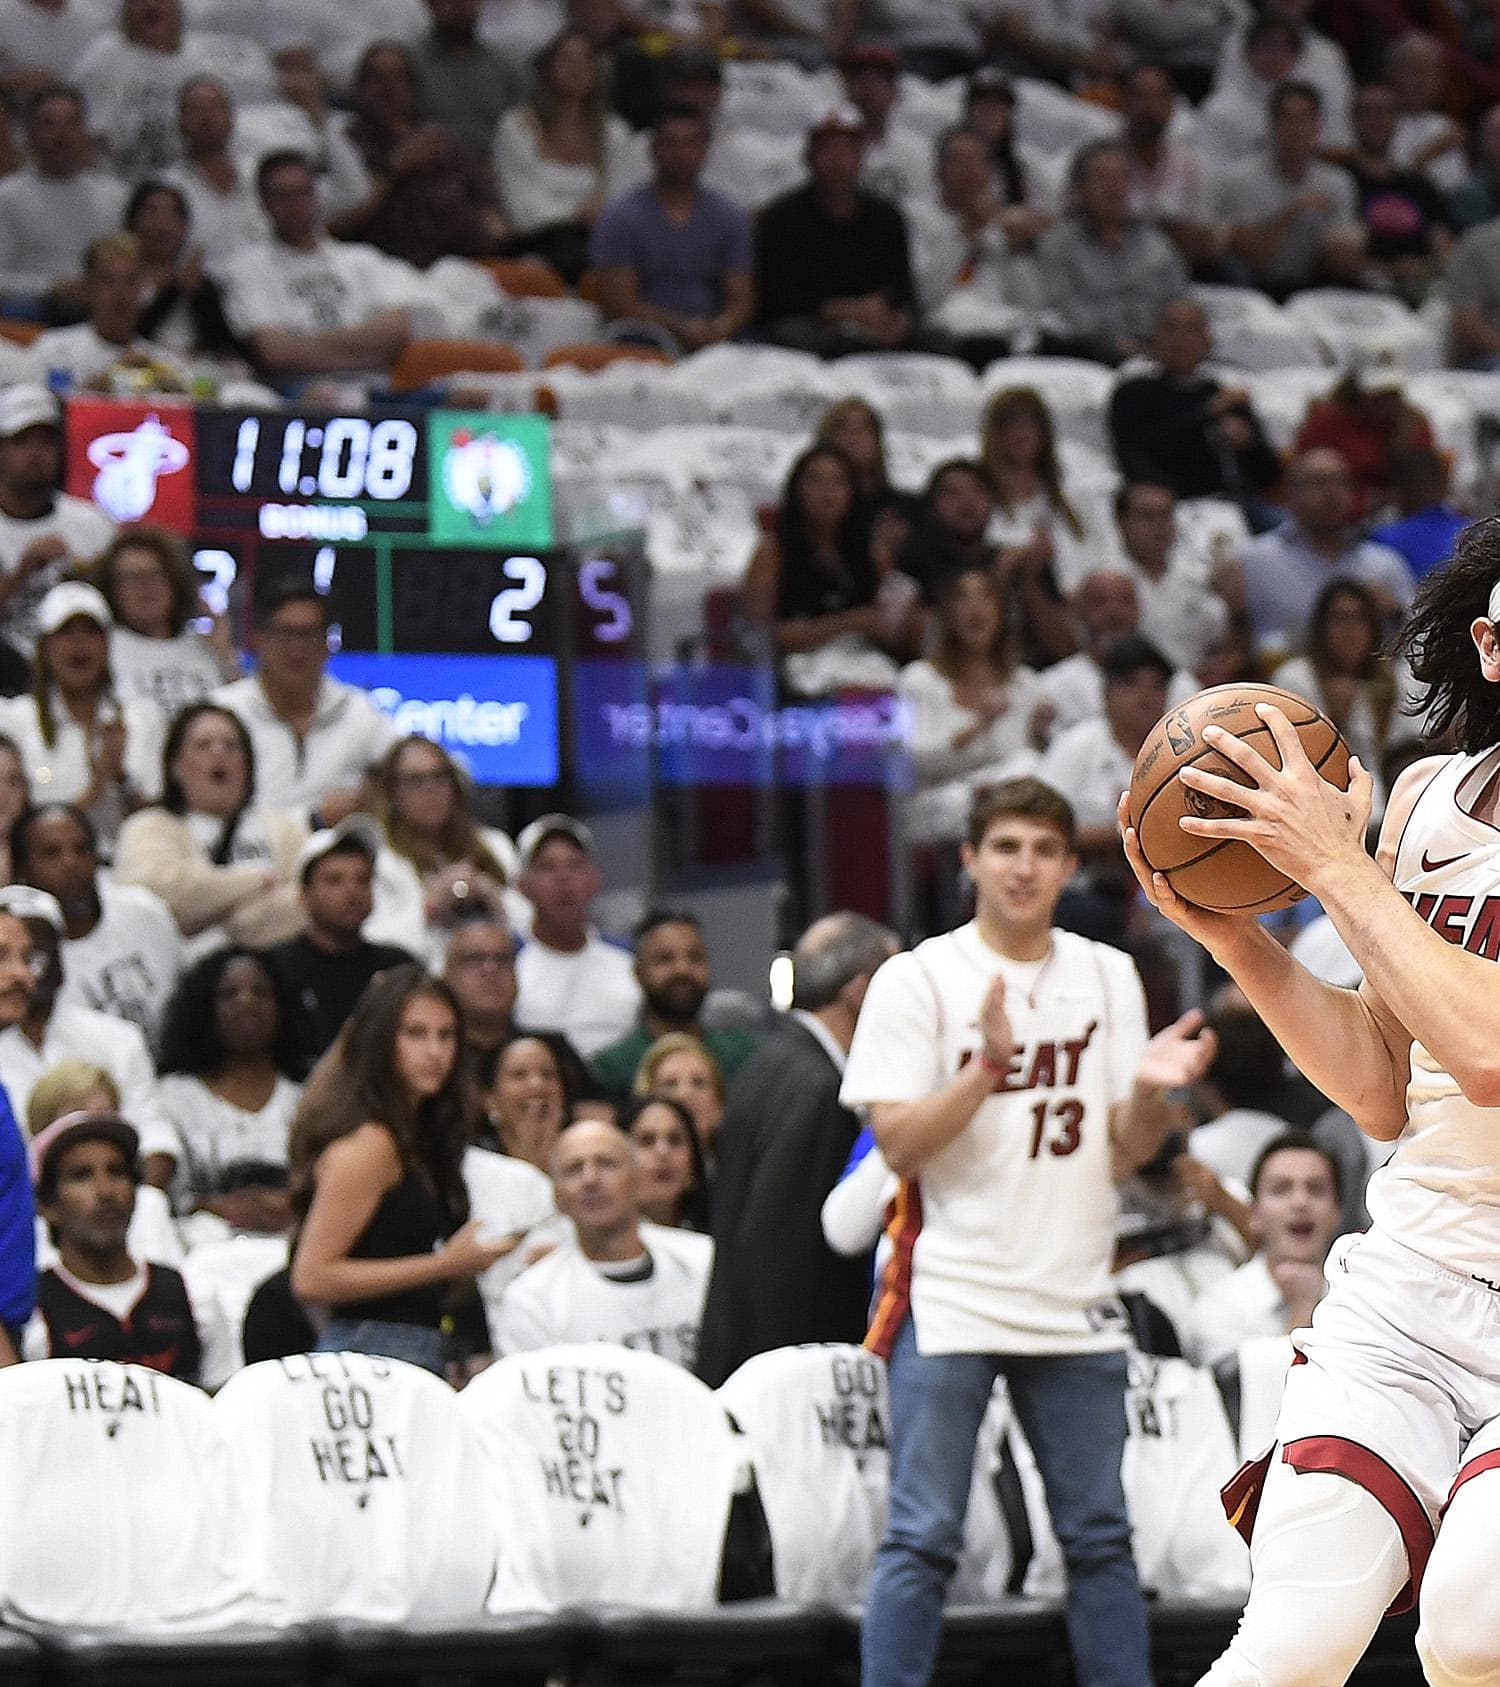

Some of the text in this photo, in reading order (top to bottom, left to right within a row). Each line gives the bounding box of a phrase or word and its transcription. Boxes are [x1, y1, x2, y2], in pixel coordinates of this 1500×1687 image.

[232, 415, 418, 500] 11:08
[489, 556, 546, 643] 2
[958, 1021, 1099, 1094] EAT
[1028, 1097, 1085, 1160] 13
[520, 1366, 627, 1415] LET'S
[831, 1355, 879, 1397] GO
[322, 1384, 374, 1432] GO
[814, 1401, 890, 1450] HEA
[308, 1434, 404, 1485] HEAT
[540, 1452, 624, 1513] HEAT
